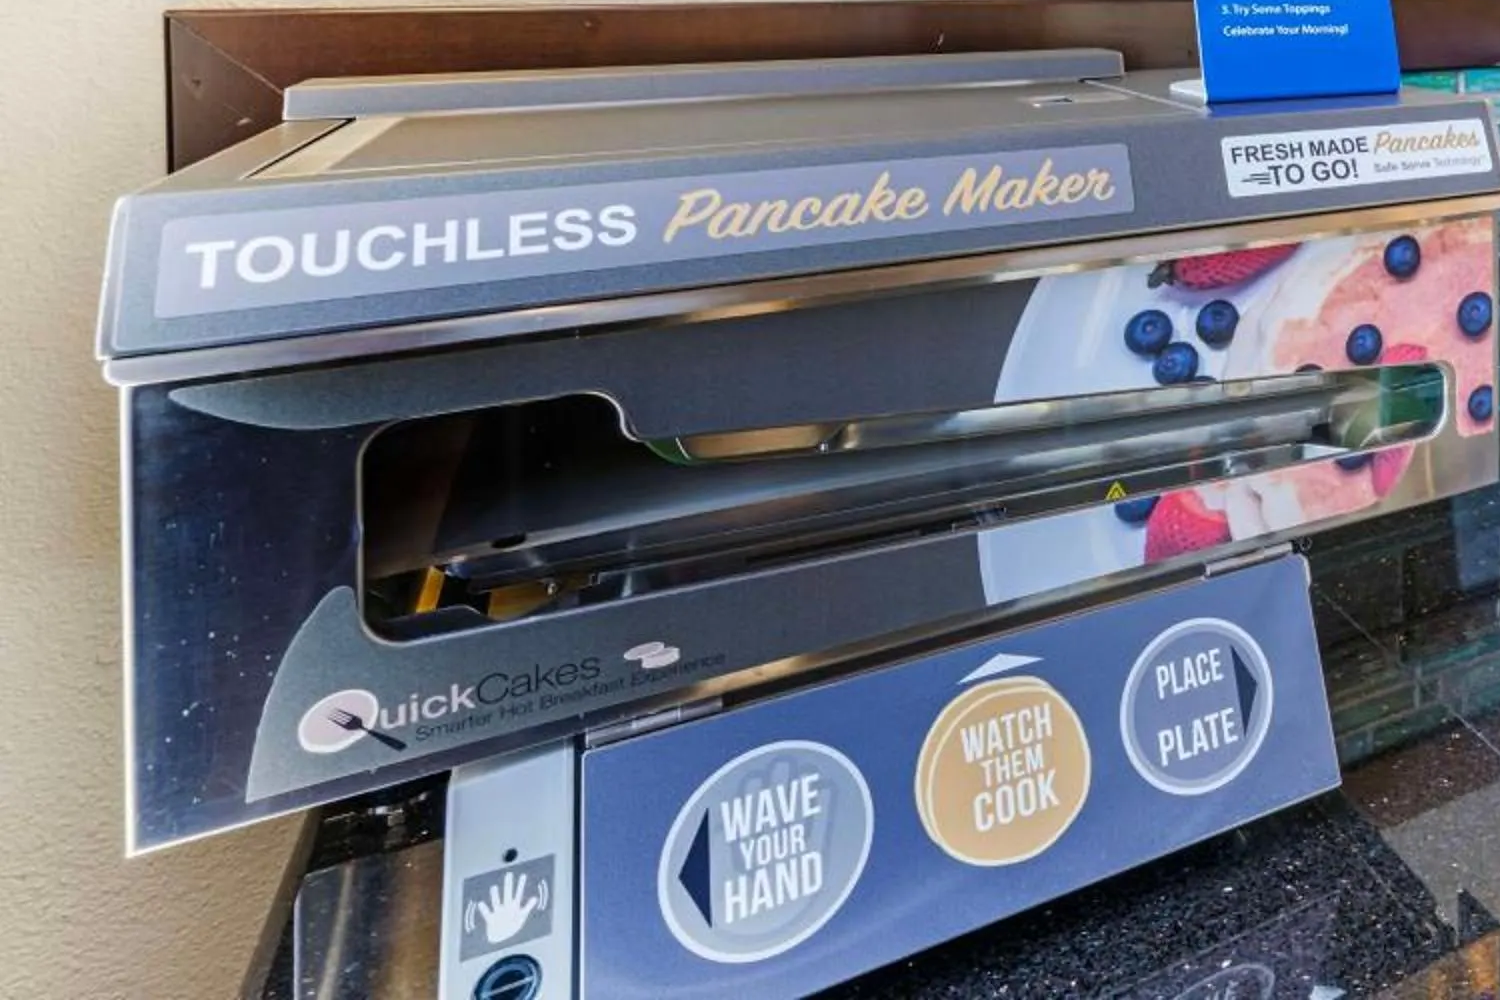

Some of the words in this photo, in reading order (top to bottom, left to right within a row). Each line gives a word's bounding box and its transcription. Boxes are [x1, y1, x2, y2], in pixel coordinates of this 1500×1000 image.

[1223, 25, 1275, 37] Celebrate
[1276, 24, 1301, 35] Your
[1301, 23, 1349, 36] Morning!
[1232, 4, 1250, 16] Try
[1251, 4, 1281, 15] Some
[1282, 3, 1331, 16] Toppings
[1231, 143, 1305, 164] FRESH
[1309, 136, 1369, 157] MADE
[1372, 124, 1481, 154] Pancakes
[1374, 161, 1397, 173] Safe
[1401, 159, 1431, 171] Serve
[1268, 163, 1305, 186] TO
[1312, 158, 1359, 182] GO!
[185, 204, 636, 289] TOUCHLESS
[663, 172, 929, 244] Pancake
[943, 159, 1115, 216] Maker
[1156, 648, 1223, 699] PLACE
[298, 656, 601, 753] QuickCakes
[415, 711, 493, 742] Smarter
[500, 699, 534, 721] Hot
[540, 676, 626, 711] Breakfast
[960, 704, 1052, 764] WATCH
[1158, 707, 1238, 766] PLATE
[981, 751, 1044, 788] THEM
[721, 774, 821, 842] WAVE
[973, 768, 1060, 832] COOK
[741, 827, 805, 872] YOUR
[724, 854, 823, 923] HAND
